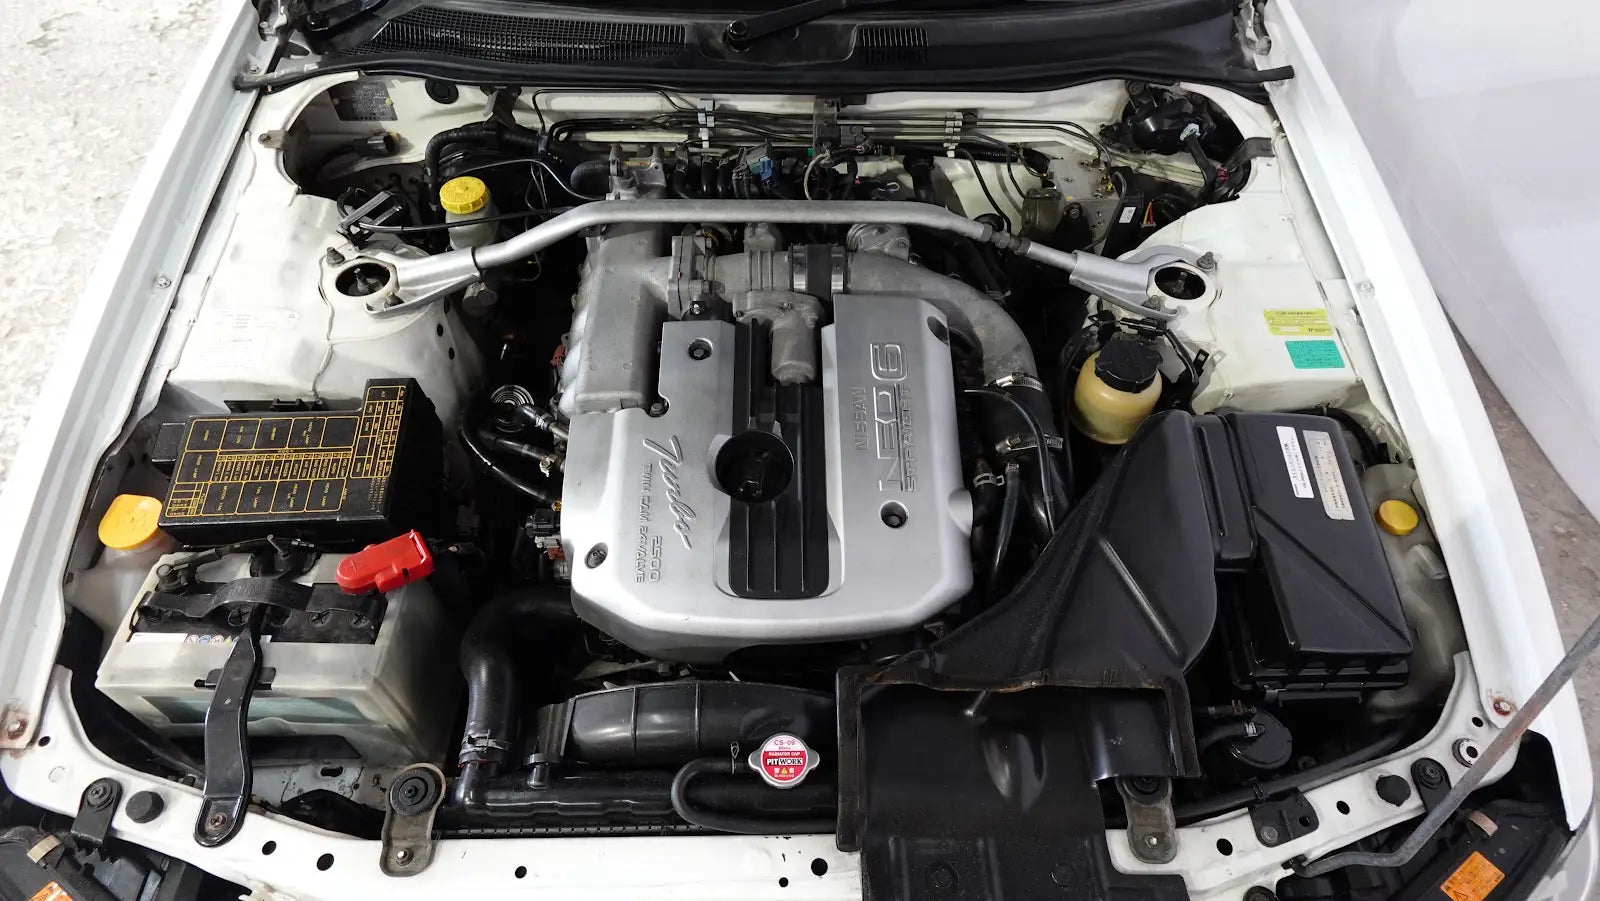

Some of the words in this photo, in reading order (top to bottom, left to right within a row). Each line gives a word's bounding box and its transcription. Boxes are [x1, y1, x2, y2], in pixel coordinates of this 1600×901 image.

[851, 386, 868, 452] NISSAN
[641, 463, 653, 493] TWIN
[643, 434, 697, 549] Turbo
[639, 496, 651, 522] CAM
[648, 536, 663, 583] 2500
